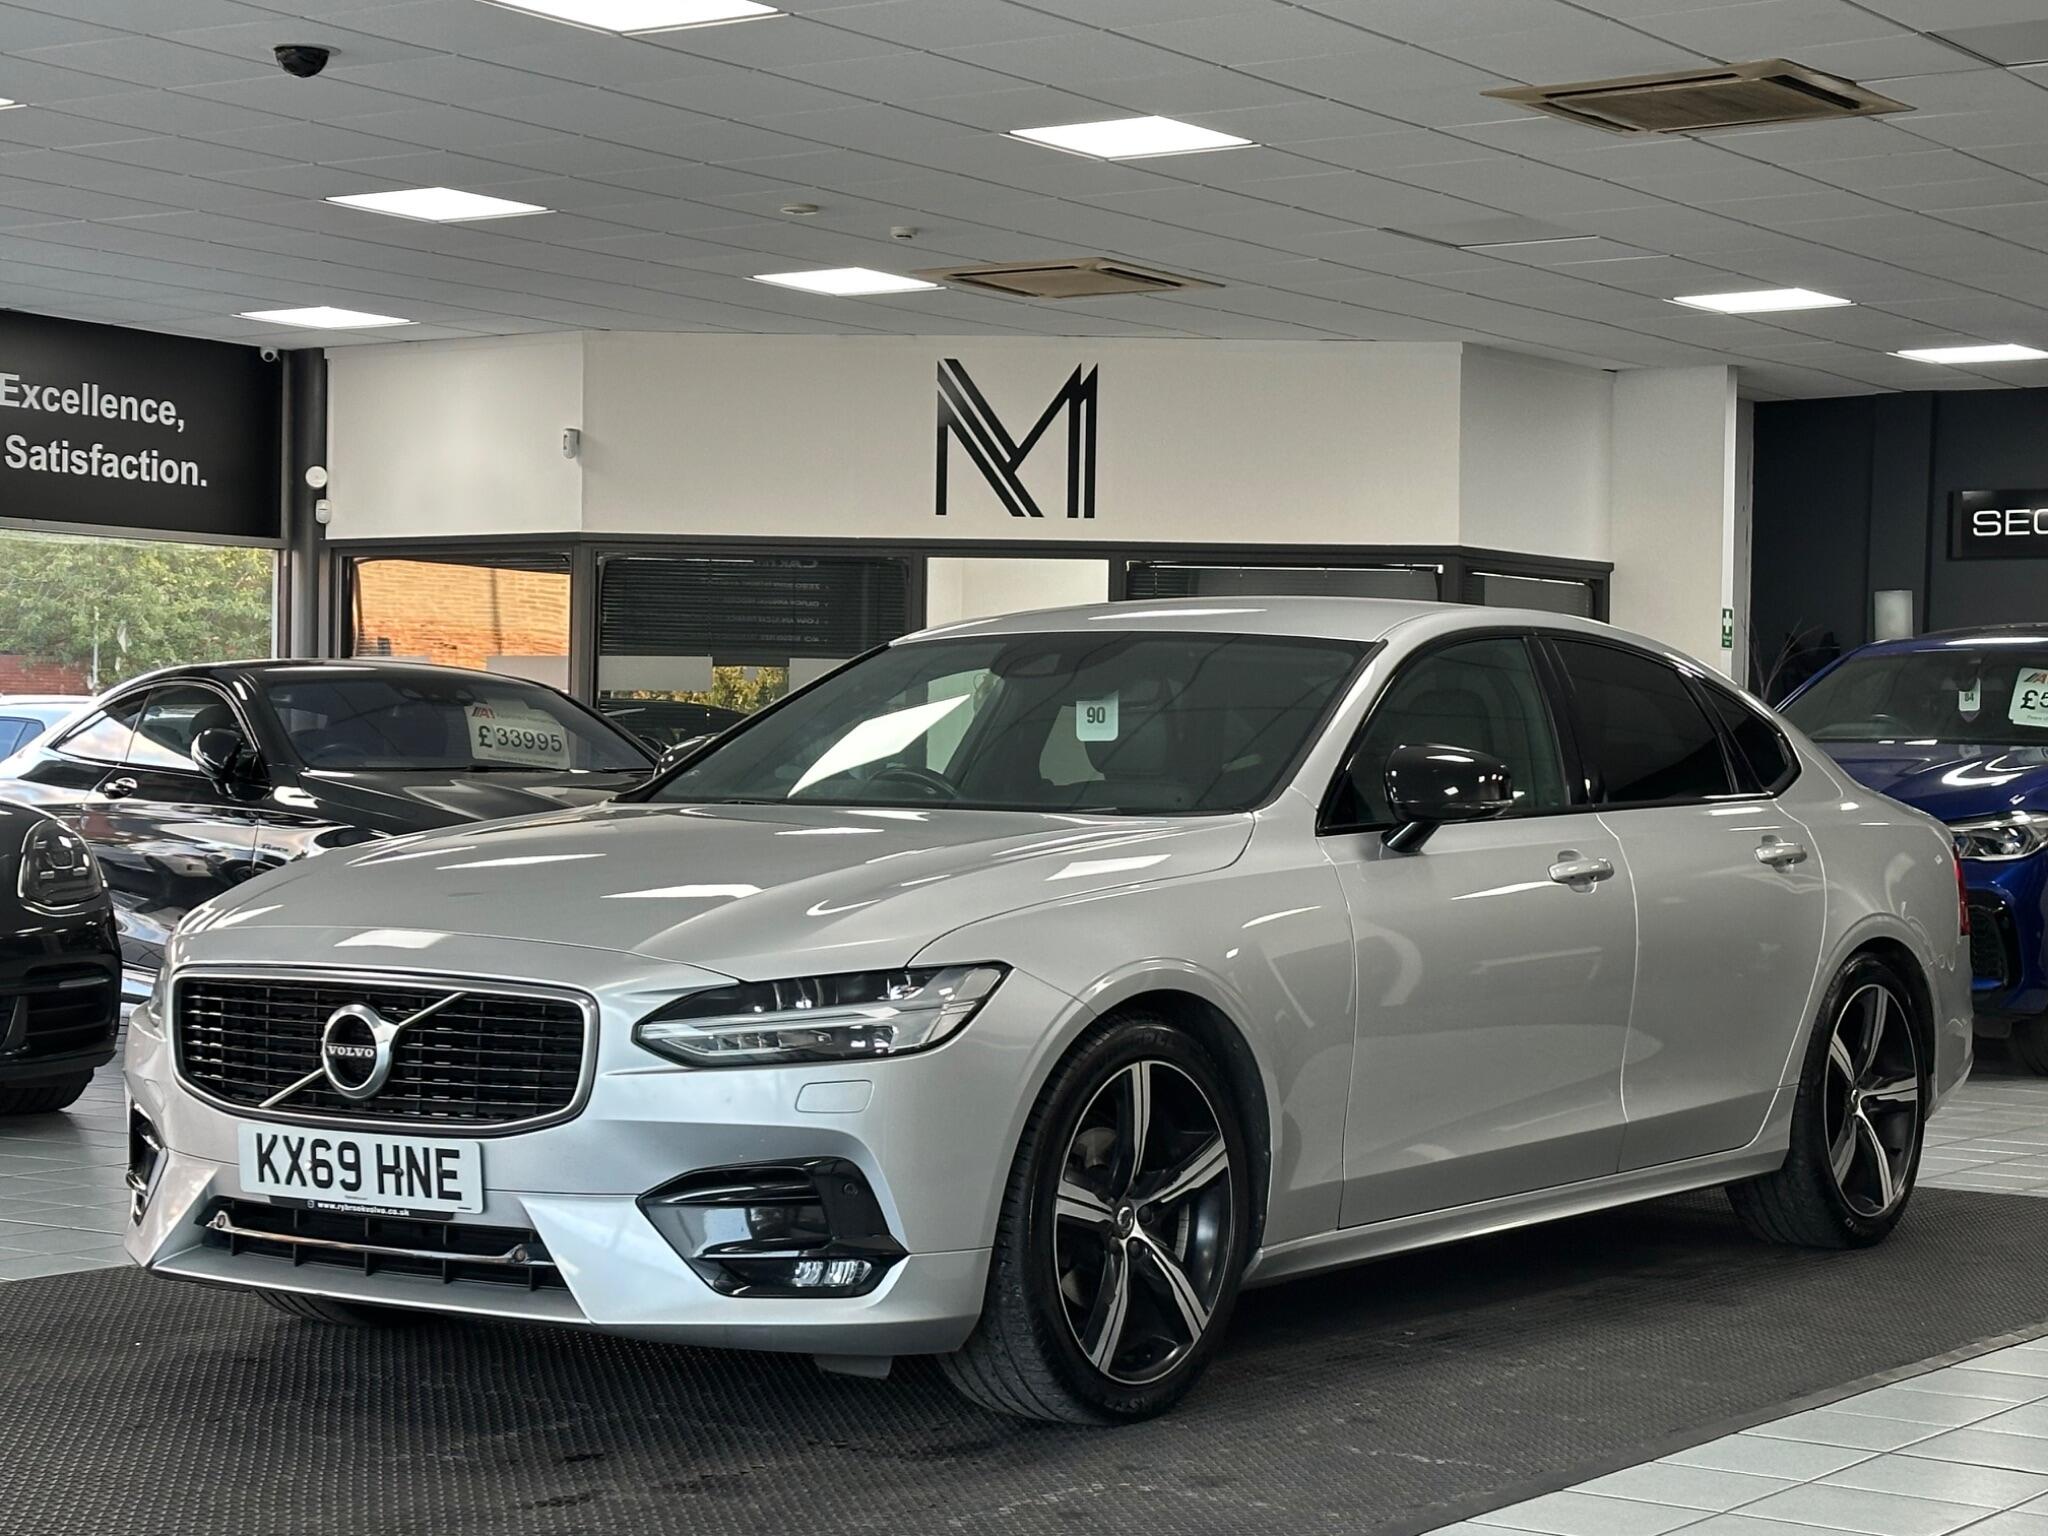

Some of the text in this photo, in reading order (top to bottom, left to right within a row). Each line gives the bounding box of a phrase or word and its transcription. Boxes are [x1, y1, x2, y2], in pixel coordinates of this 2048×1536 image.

[0, 372, 185, 433] Excellence,
[4, 434, 208, 487] Satisfaction.
[1086, 706, 1106, 724] 90
[478, 725, 562, 753] £33995
[327, 1045, 375, 1058] VOLVO
[255, 1132, 463, 1201] KX69 HNE
